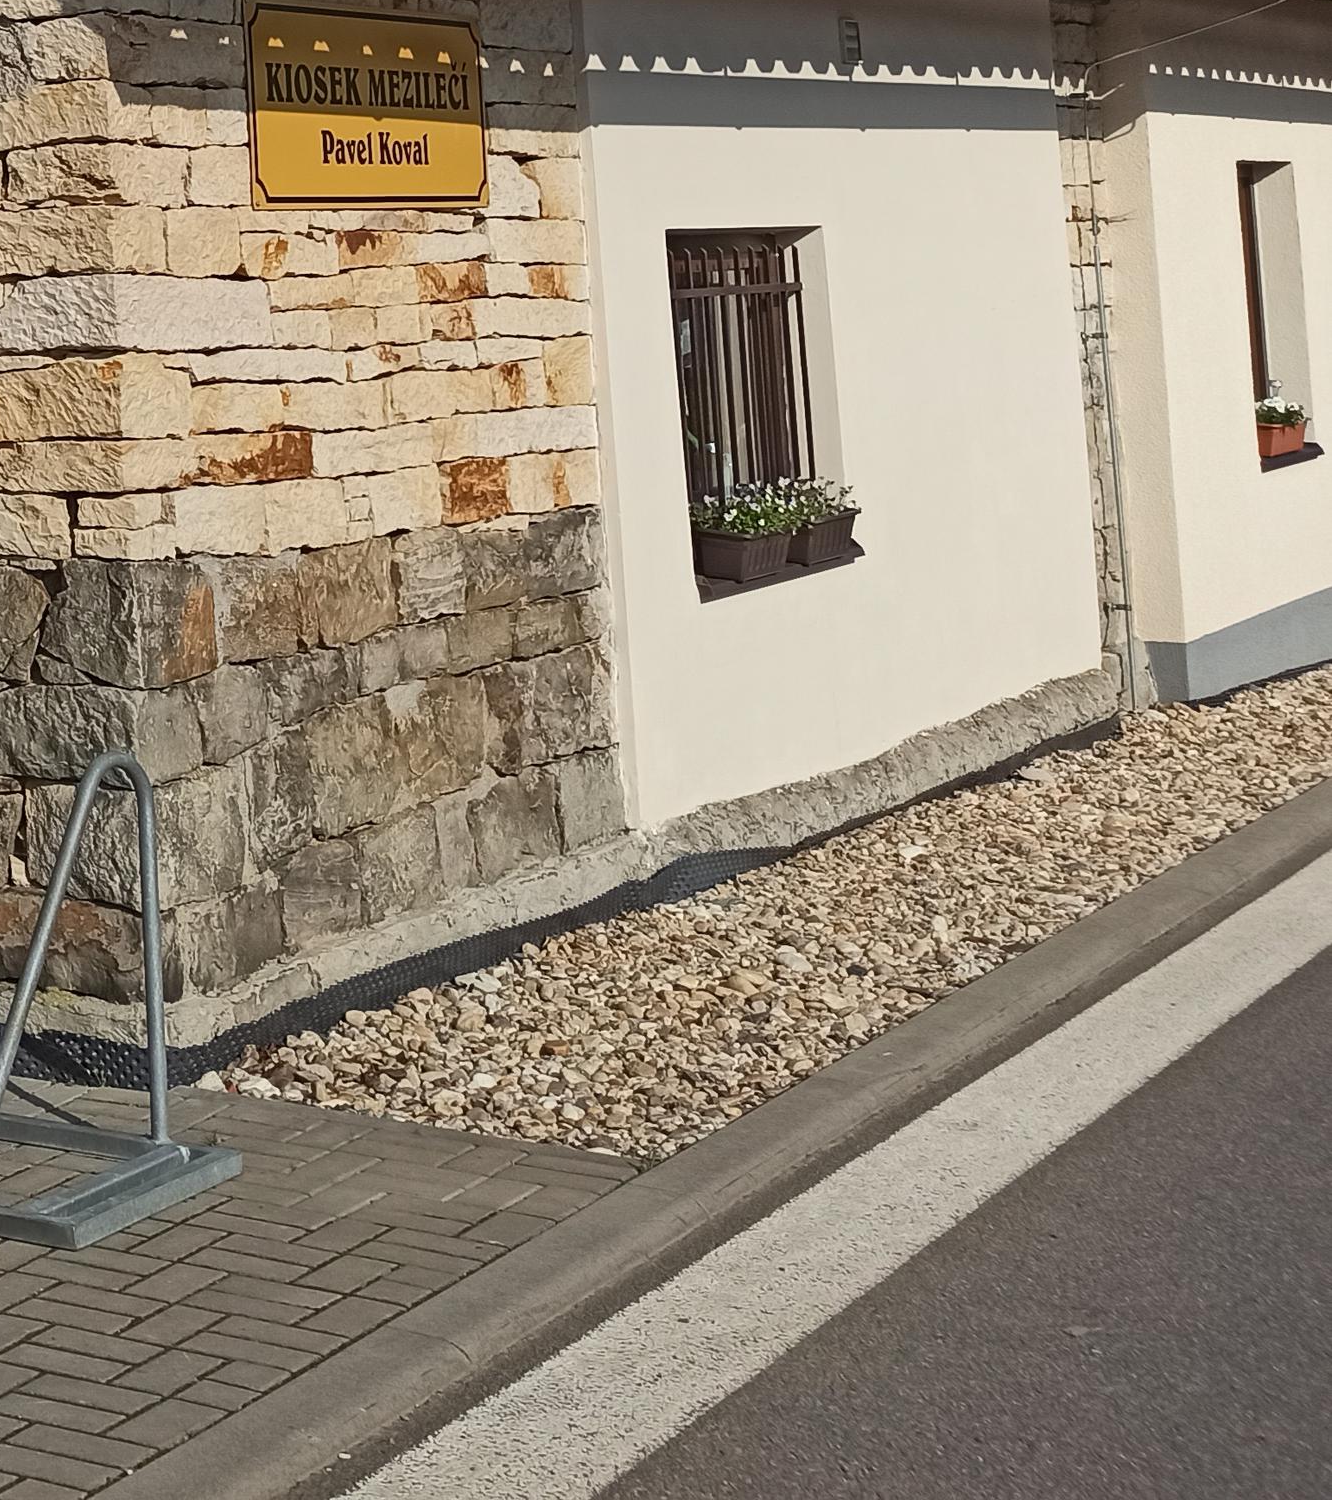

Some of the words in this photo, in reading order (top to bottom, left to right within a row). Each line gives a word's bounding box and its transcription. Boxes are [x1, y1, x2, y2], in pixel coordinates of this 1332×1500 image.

[265, 62, 362, 106] KIOSEK
[368, 62, 470, 110] MEZILEČÍ
[321, 130, 373, 165] Pavel
[378, 131, 429, 165] Koval
